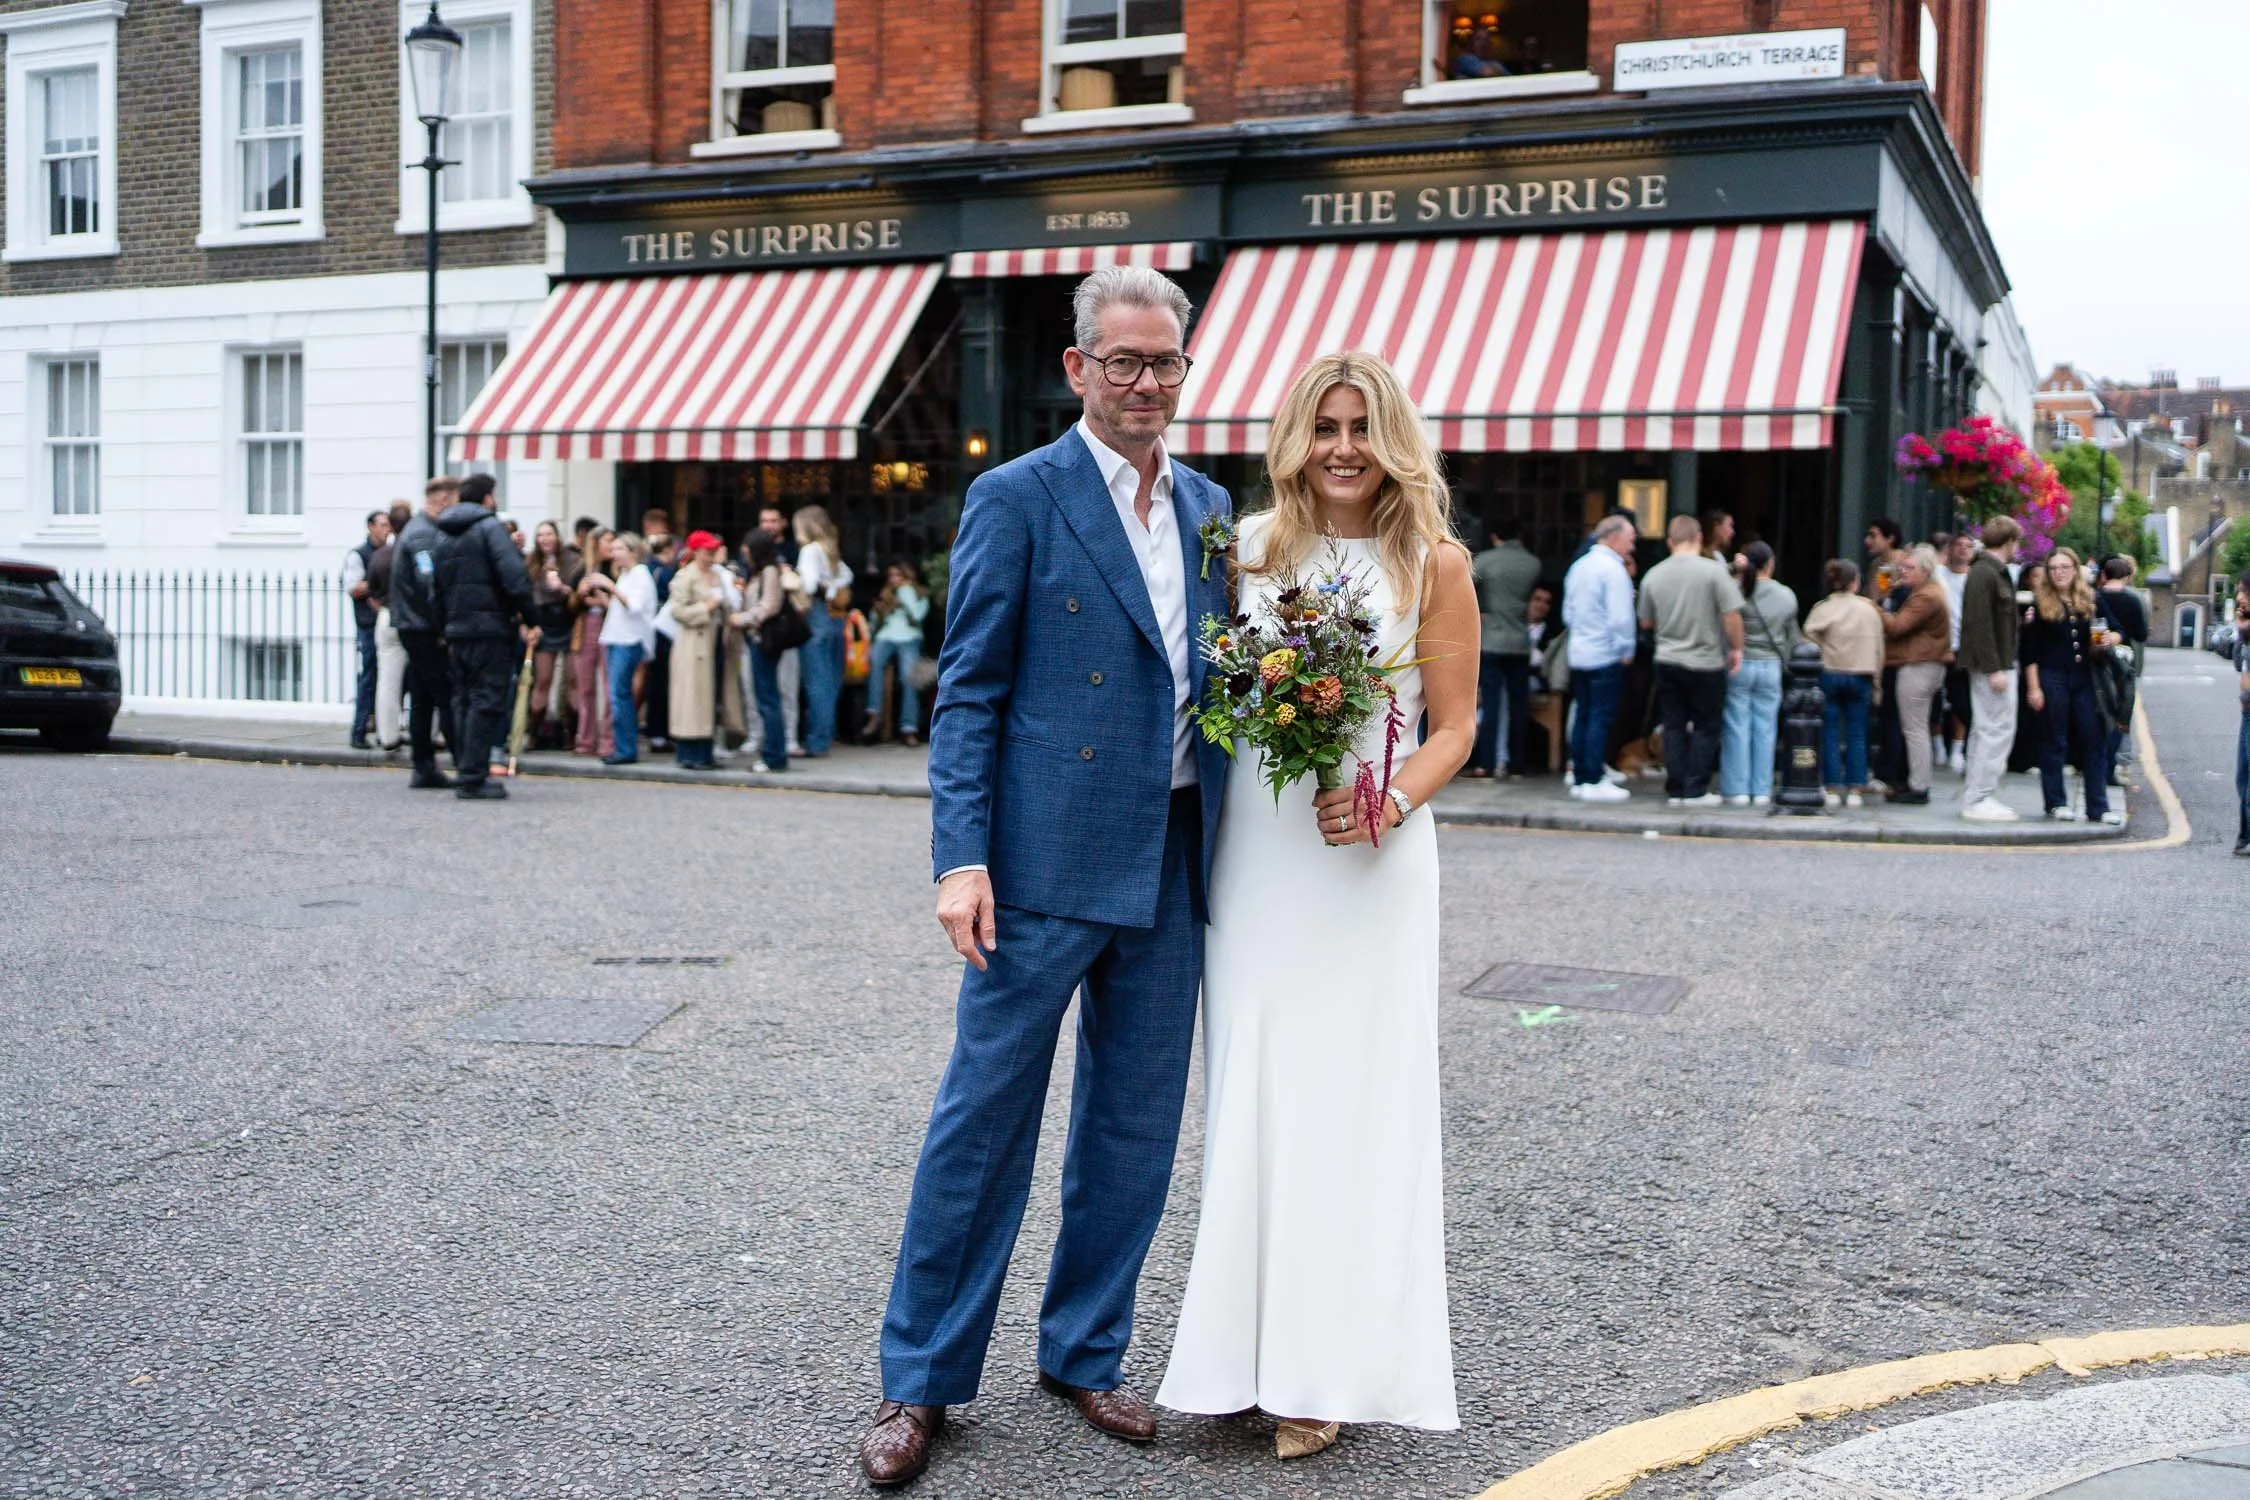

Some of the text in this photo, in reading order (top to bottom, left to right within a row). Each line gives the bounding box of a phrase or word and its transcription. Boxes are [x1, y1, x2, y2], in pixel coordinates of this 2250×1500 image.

[1618, 50, 1753, 74] CHRISTCHURCH
[1760, 44, 1839, 65] TERRACE
[1302, 174, 1669, 226] THE SURPRISE
[621, 218, 902, 264] THE SURPRISE
